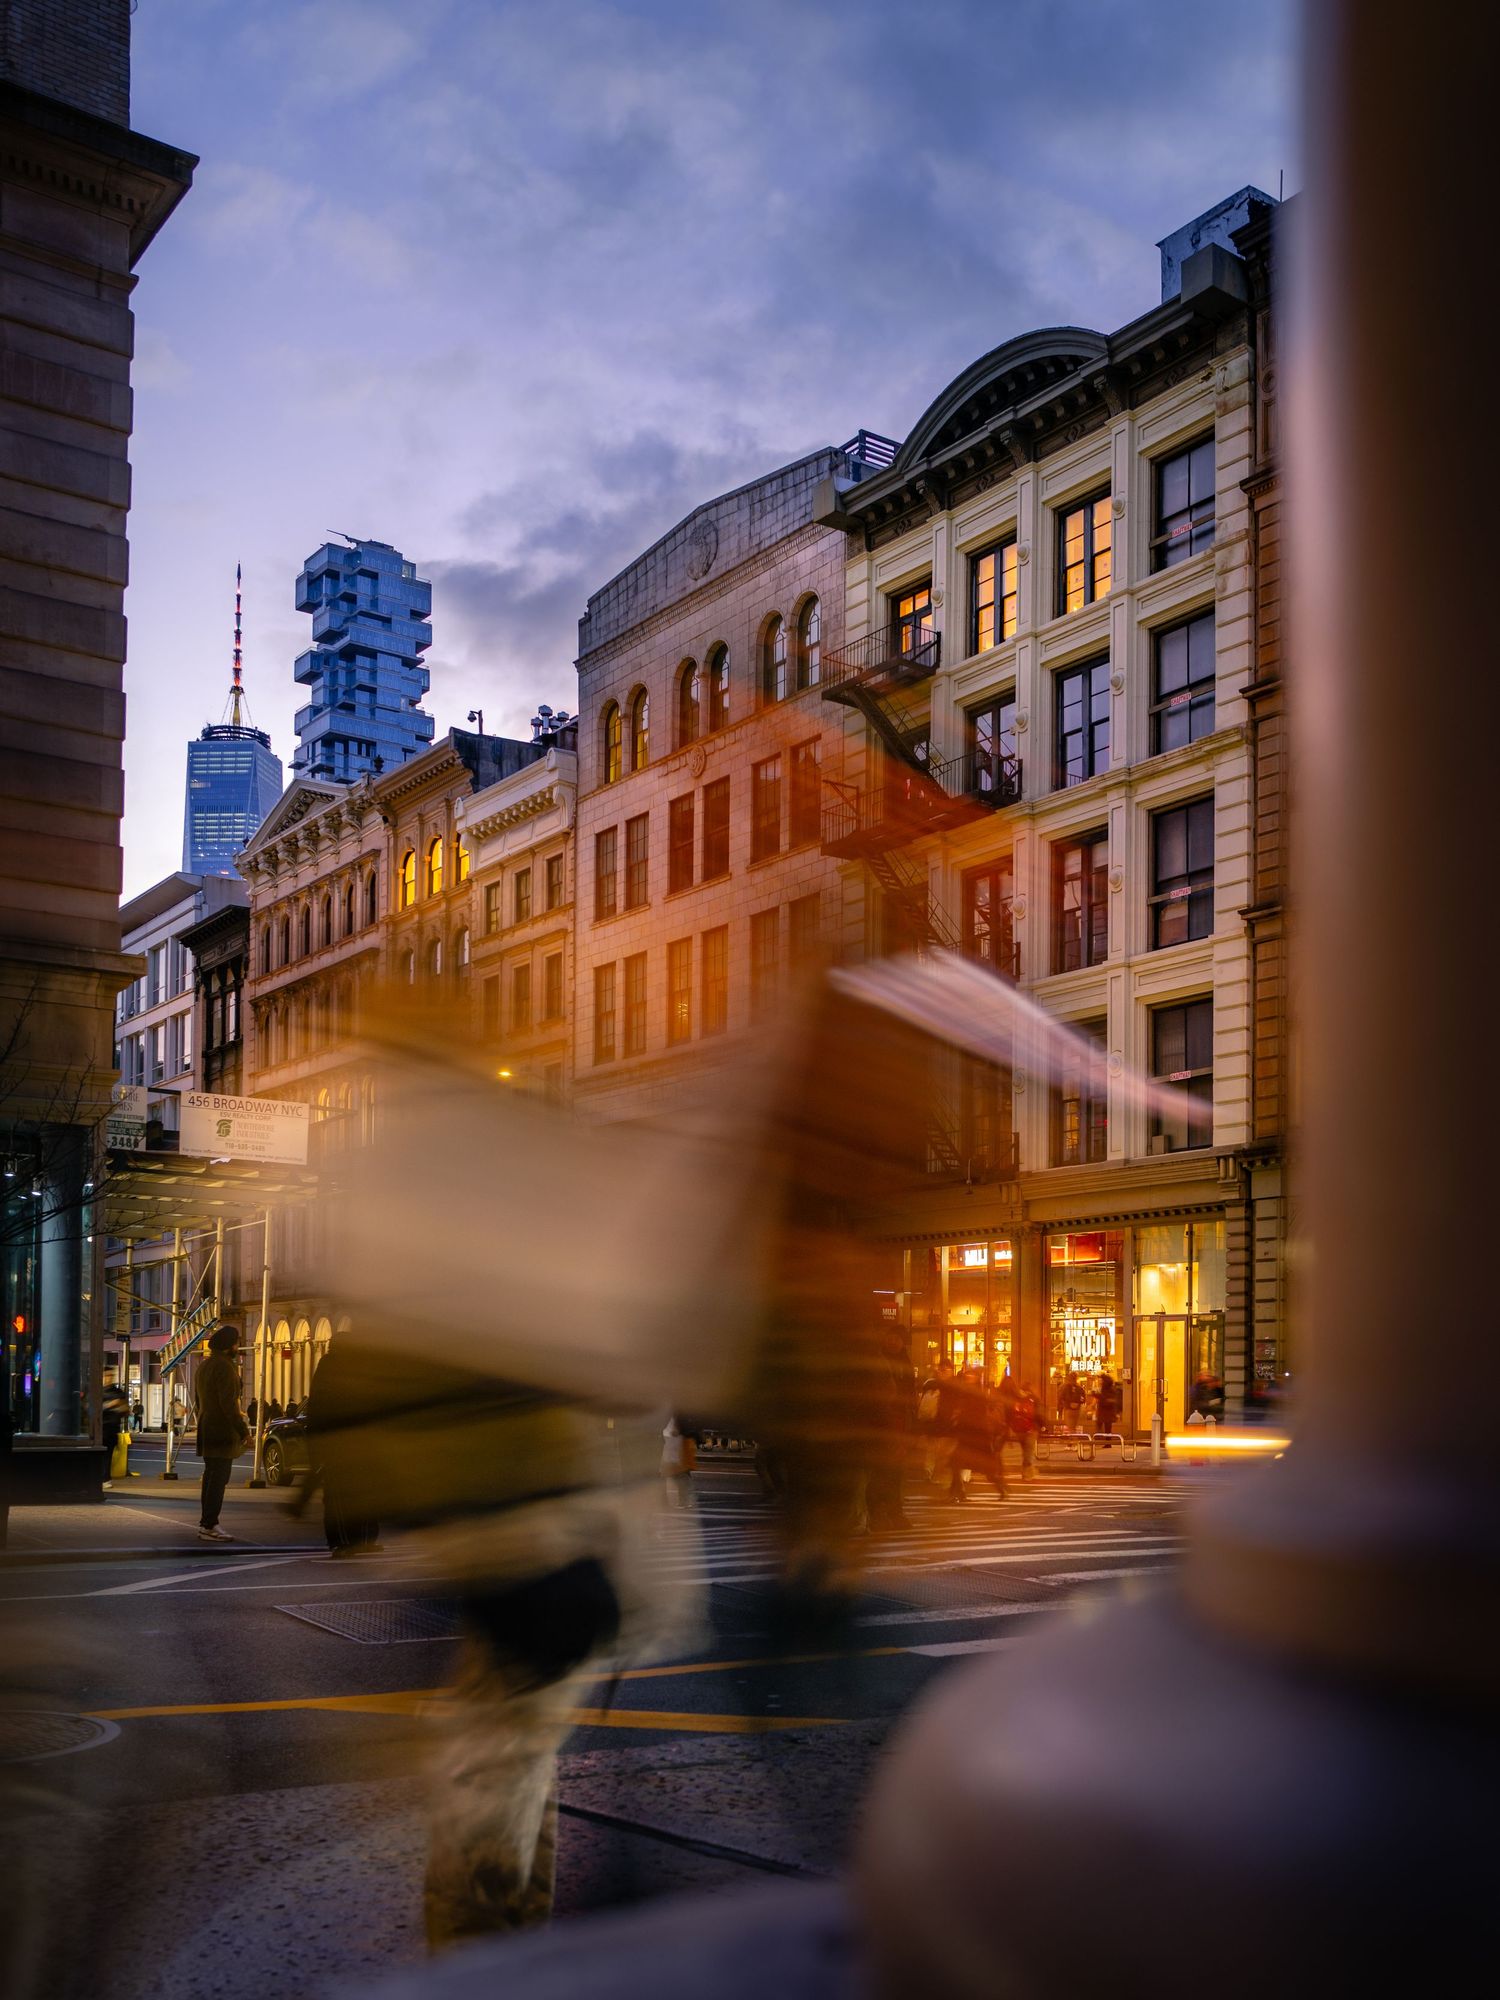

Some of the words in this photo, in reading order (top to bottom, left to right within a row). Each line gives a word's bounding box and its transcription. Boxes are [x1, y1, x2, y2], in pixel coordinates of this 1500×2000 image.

[188, 1095, 210, 1107] 456
[213, 1097, 278, 1114] BROADWAY
[281, 1104, 304, 1117] NYC
[232, 1112, 253, 1120] REALTY
[881, 1307, 897, 1316] MUJI
[1069, 1334, 1106, 1358] MUJI
[1071, 1359, 1102, 1371] 無印良品
